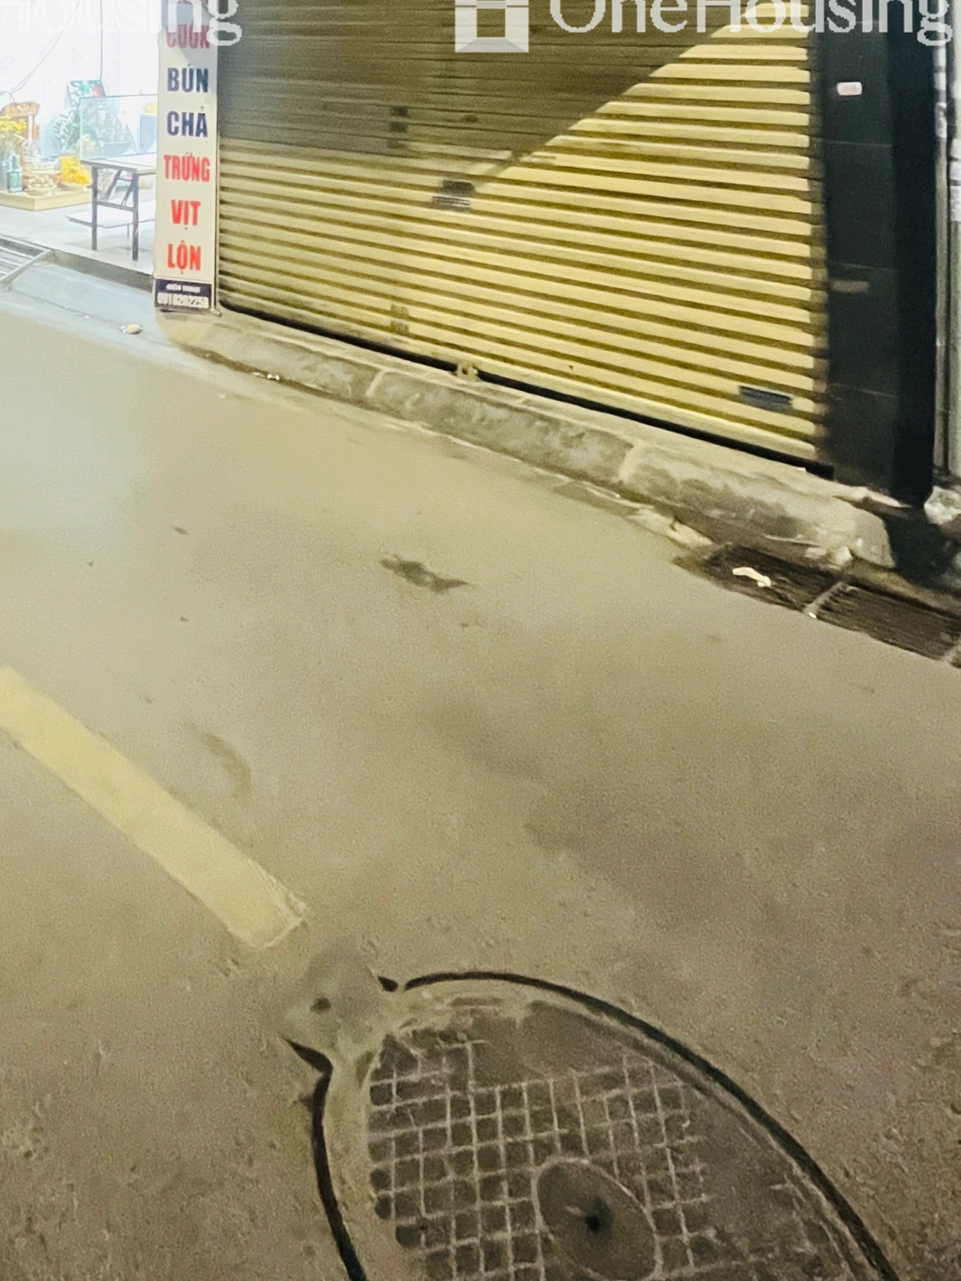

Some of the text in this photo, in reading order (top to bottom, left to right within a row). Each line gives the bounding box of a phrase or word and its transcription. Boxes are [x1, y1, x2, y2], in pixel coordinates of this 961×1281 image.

[166, 63, 210, 93] BÚN
[166, 106, 209, 138] CHẢ
[163, 152, 211, 182] TRỨNG
[170, 199, 201, 231] VỊT
[167, 240, 202, 275] LỘN
